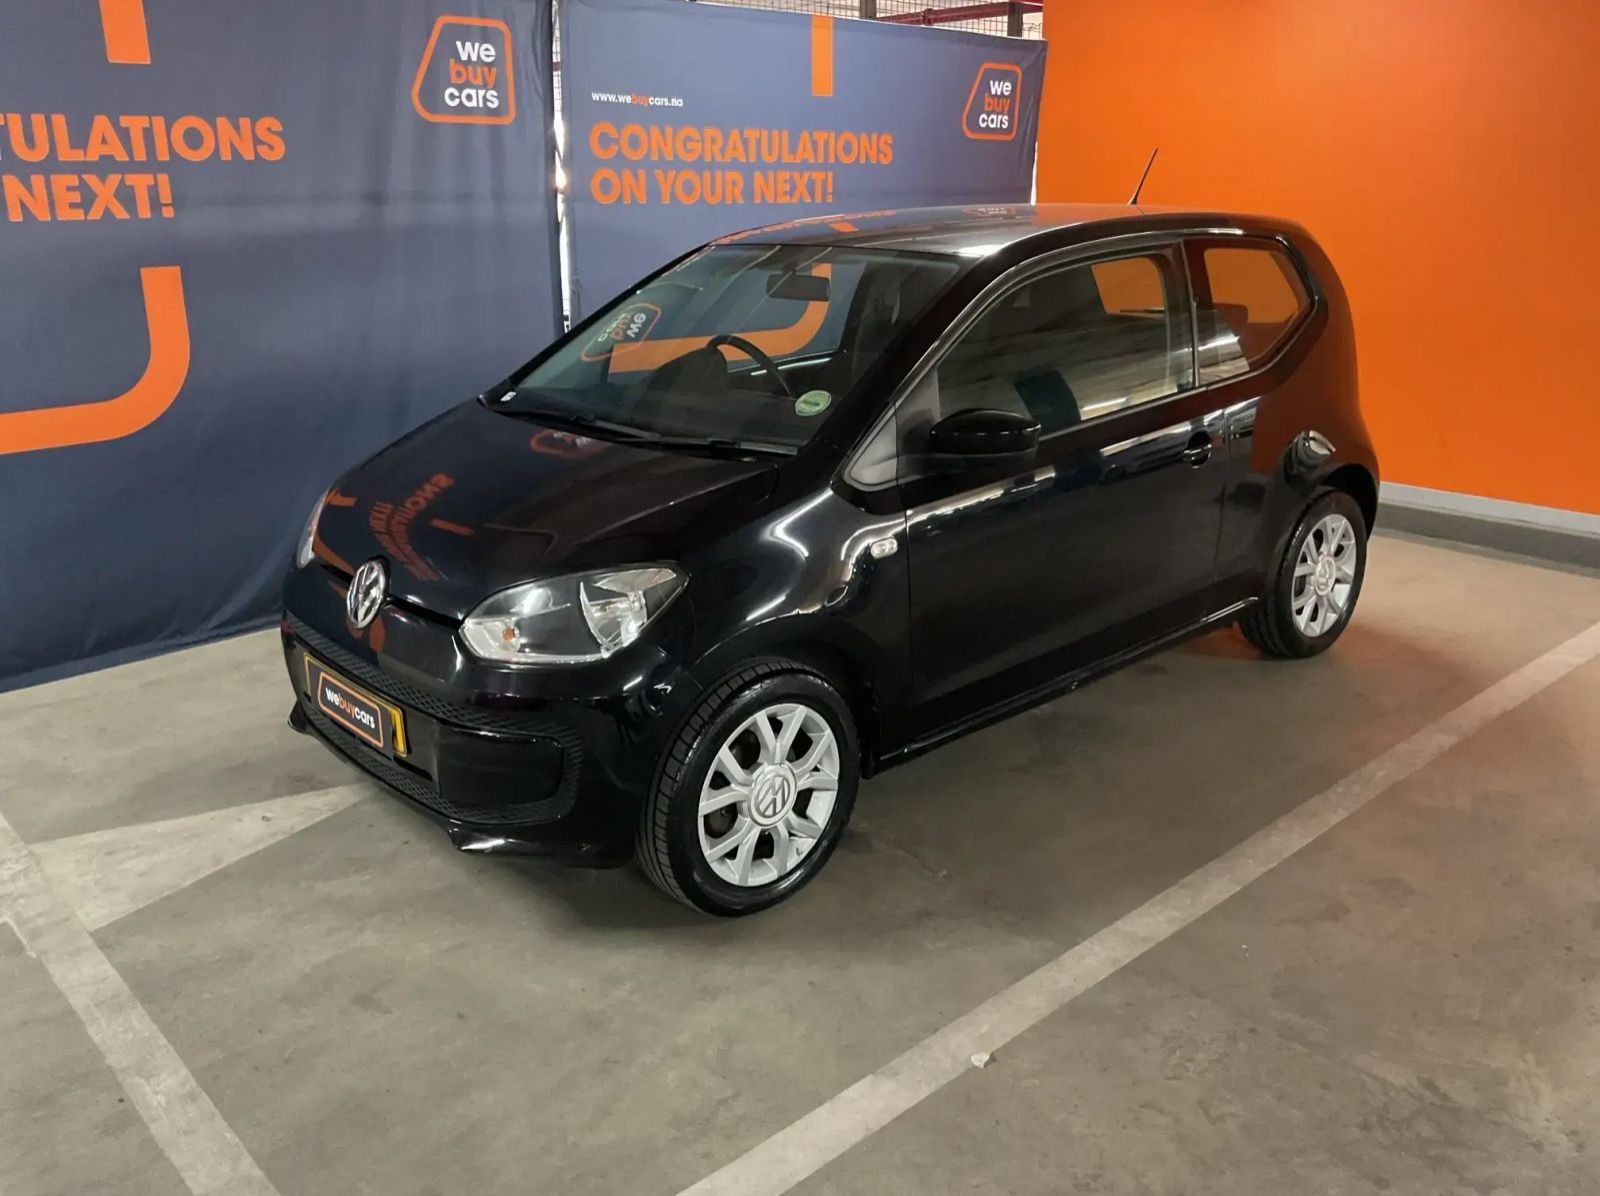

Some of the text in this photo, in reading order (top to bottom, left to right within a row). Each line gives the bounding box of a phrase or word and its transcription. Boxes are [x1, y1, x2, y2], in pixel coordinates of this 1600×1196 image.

[455, 40, 496, 62] we
[449, 58, 496, 89] buy
[444, 87, 499, 108] cars
[591, 92, 683, 107] www.webuycars.na
[990, 80, 1011, 96] we
[984, 94, 1010, 113] buy
[979, 113, 1009, 128] cars
[0, 112, 286, 163] ULATIONS
[588, 121, 893, 165] CONGRATULATIONS
[2, 172, 174, 222] NEXT!
[590, 167, 833, 205] ON YOUR NEXT!
[326, 686, 375, 729] webuycars
